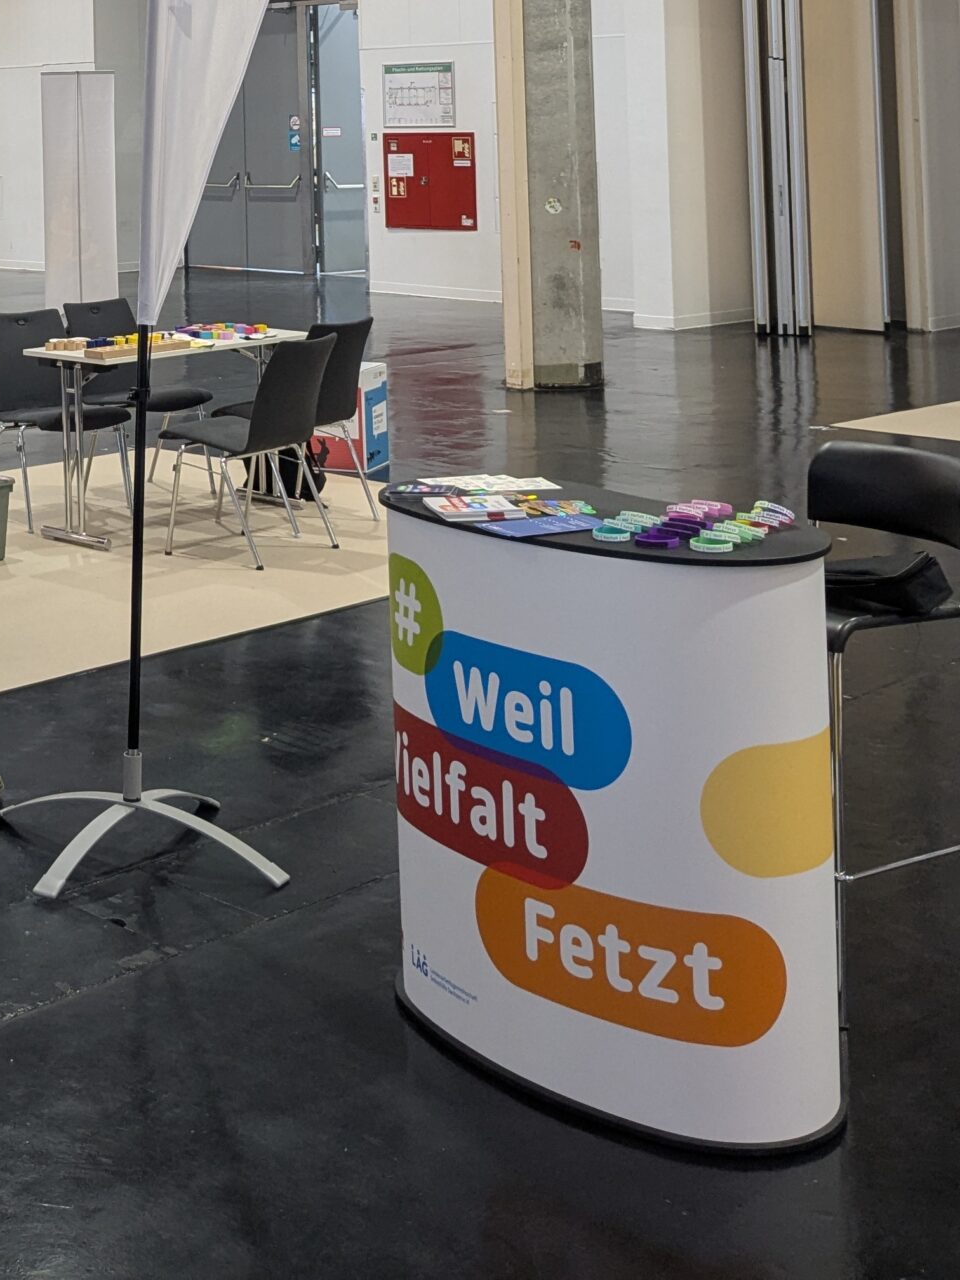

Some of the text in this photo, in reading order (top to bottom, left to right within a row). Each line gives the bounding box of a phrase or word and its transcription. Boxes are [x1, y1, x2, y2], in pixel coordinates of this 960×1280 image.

[394, 578, 575, 756] # Weil
[524, 896, 725, 1011] Fetzt
